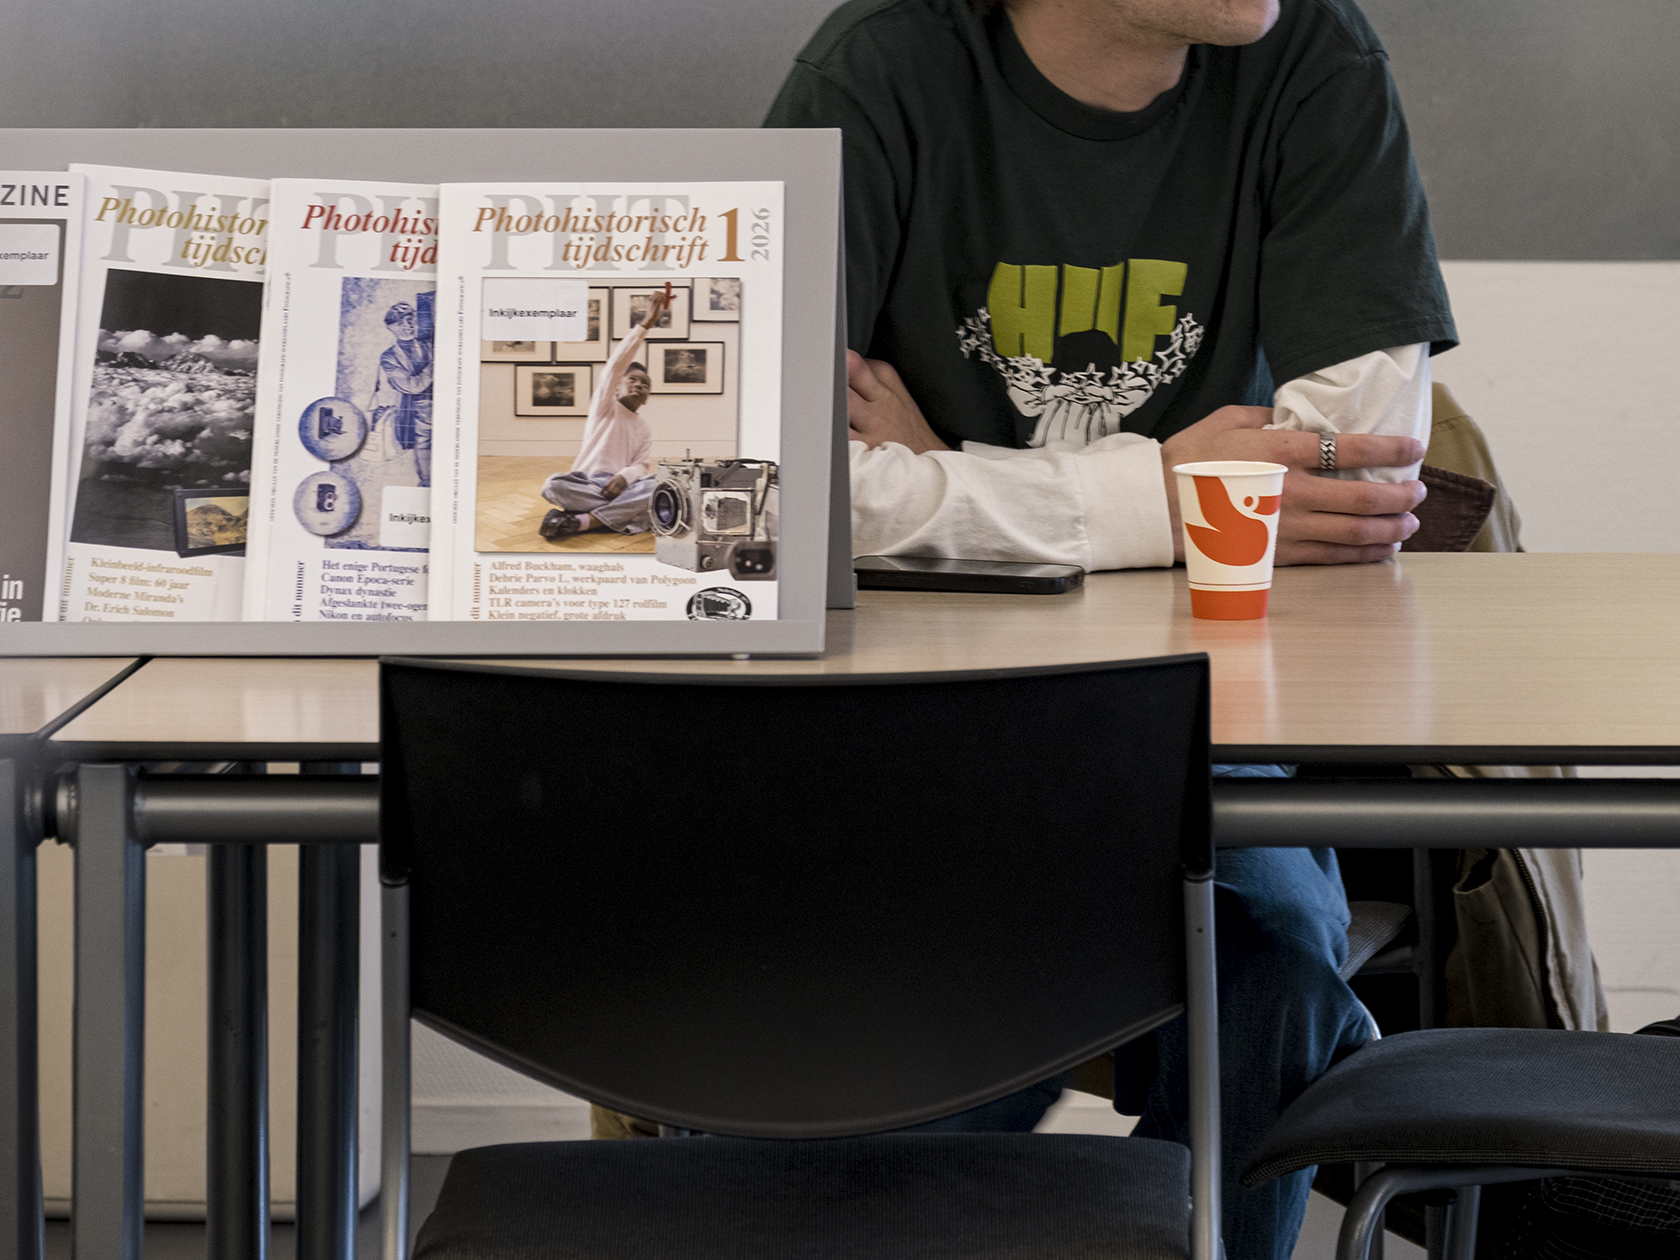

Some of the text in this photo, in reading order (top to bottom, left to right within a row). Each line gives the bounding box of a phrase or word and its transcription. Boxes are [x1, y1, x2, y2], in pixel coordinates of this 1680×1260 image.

[0, 184, 70, 208] ZINE
[94, 196, 268, 237] Photohistor
[472, 206, 708, 235] Photohistorisch
[100, 184, 269, 276] PH
[717, 207, 746, 262] 1
[751, 207, 770, 262] 2026
[561, 235, 710, 269] tijdschrift
[488, 307, 578, 320] Inkijkexemplaar
[90, 556, 214, 577] Kleinbeeld-infraroodfilm
[322, 560, 340, 570] Het
[342, 561, 369, 572] enige
[371, 562, 420, 574] Portugese
[490, 561, 625, 573] Alfred Buckham, waaghals
[88, 572, 117, 585] Super
[119, 574, 127, 585] 8
[154, 577, 167, 588] 60
[168, 579, 190, 591] jaar
[321, 572, 415, 586] Canon Epoca-serie
[489, 573, 522, 583] Debrie
[525, 573, 556, 583] Parvo
[571, 573, 627, 586] werkpaard
[630, 575, 648, 585] van
[651, 574, 697, 587] Polygoon
[86, 586, 131, 601] Moderne
[320, 585, 397, 598] Dynax dynastie
[489, 586, 598, 595] Kalenders en klokken
[84, 601, 175, 618] Dr. Erich Salomon
[319, 598, 378, 609] Afgeslankte
[489, 598, 512, 608] TLR
[563, 599, 585, 608] voor
[587, 599, 610, 611] type
[613, 599, 630, 608] 127
[632, 599, 668, 609] rolfilm
[0, 601, 21, 622] ie
[319, 610, 349, 620] Nikon
[351, 613, 363, 621] en
[488, 609, 515, 620] Klein
[563, 611, 589, 621] grote
[592, 610, 627, 620] afdruk
